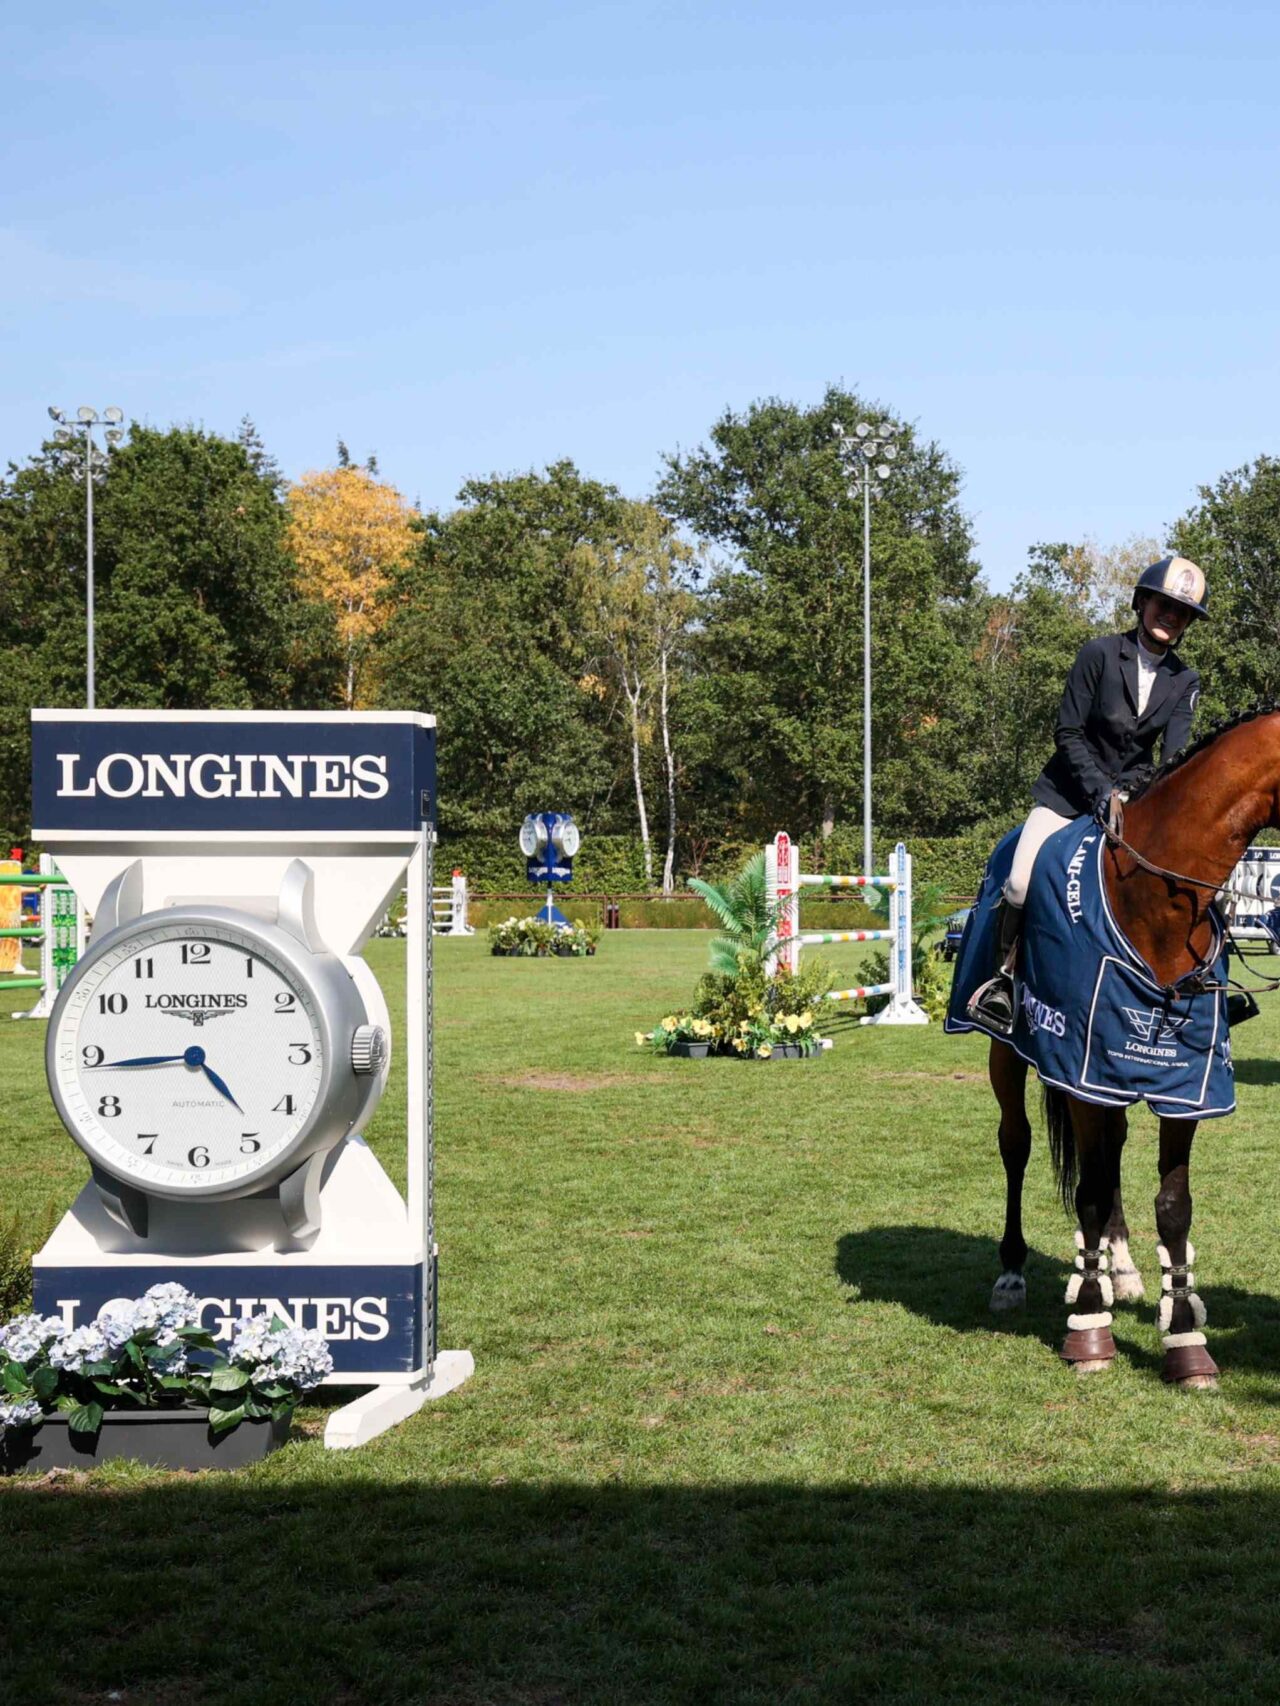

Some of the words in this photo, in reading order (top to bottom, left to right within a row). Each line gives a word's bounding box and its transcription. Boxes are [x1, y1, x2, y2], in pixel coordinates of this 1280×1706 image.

[56, 753, 389, 799] LONGINES
[1067, 836, 1097, 924] LAMI-CELL
[179, 943, 211, 964] 12
[134, 958, 154, 978] 11
[245, 957, 253, 978] 1
[98, 992, 128, 1014] 10
[145, 994, 248, 1009] LONGINES
[274, 992, 296, 1014] 2
[82, 1045, 105, 1067] 9
[288, 1043, 312, 1065] 3
[1125, 1041, 1177, 1058] LONGINES
[98, 1095, 122, 1117] 8
[172, 1100, 225, 1108] AUTOMATIC
[271, 1094, 297, 1115] 4
[137, 1133, 159, 1154] 7
[239, 1132, 260, 1154] 5
[188, 1146, 210, 1168] 6
